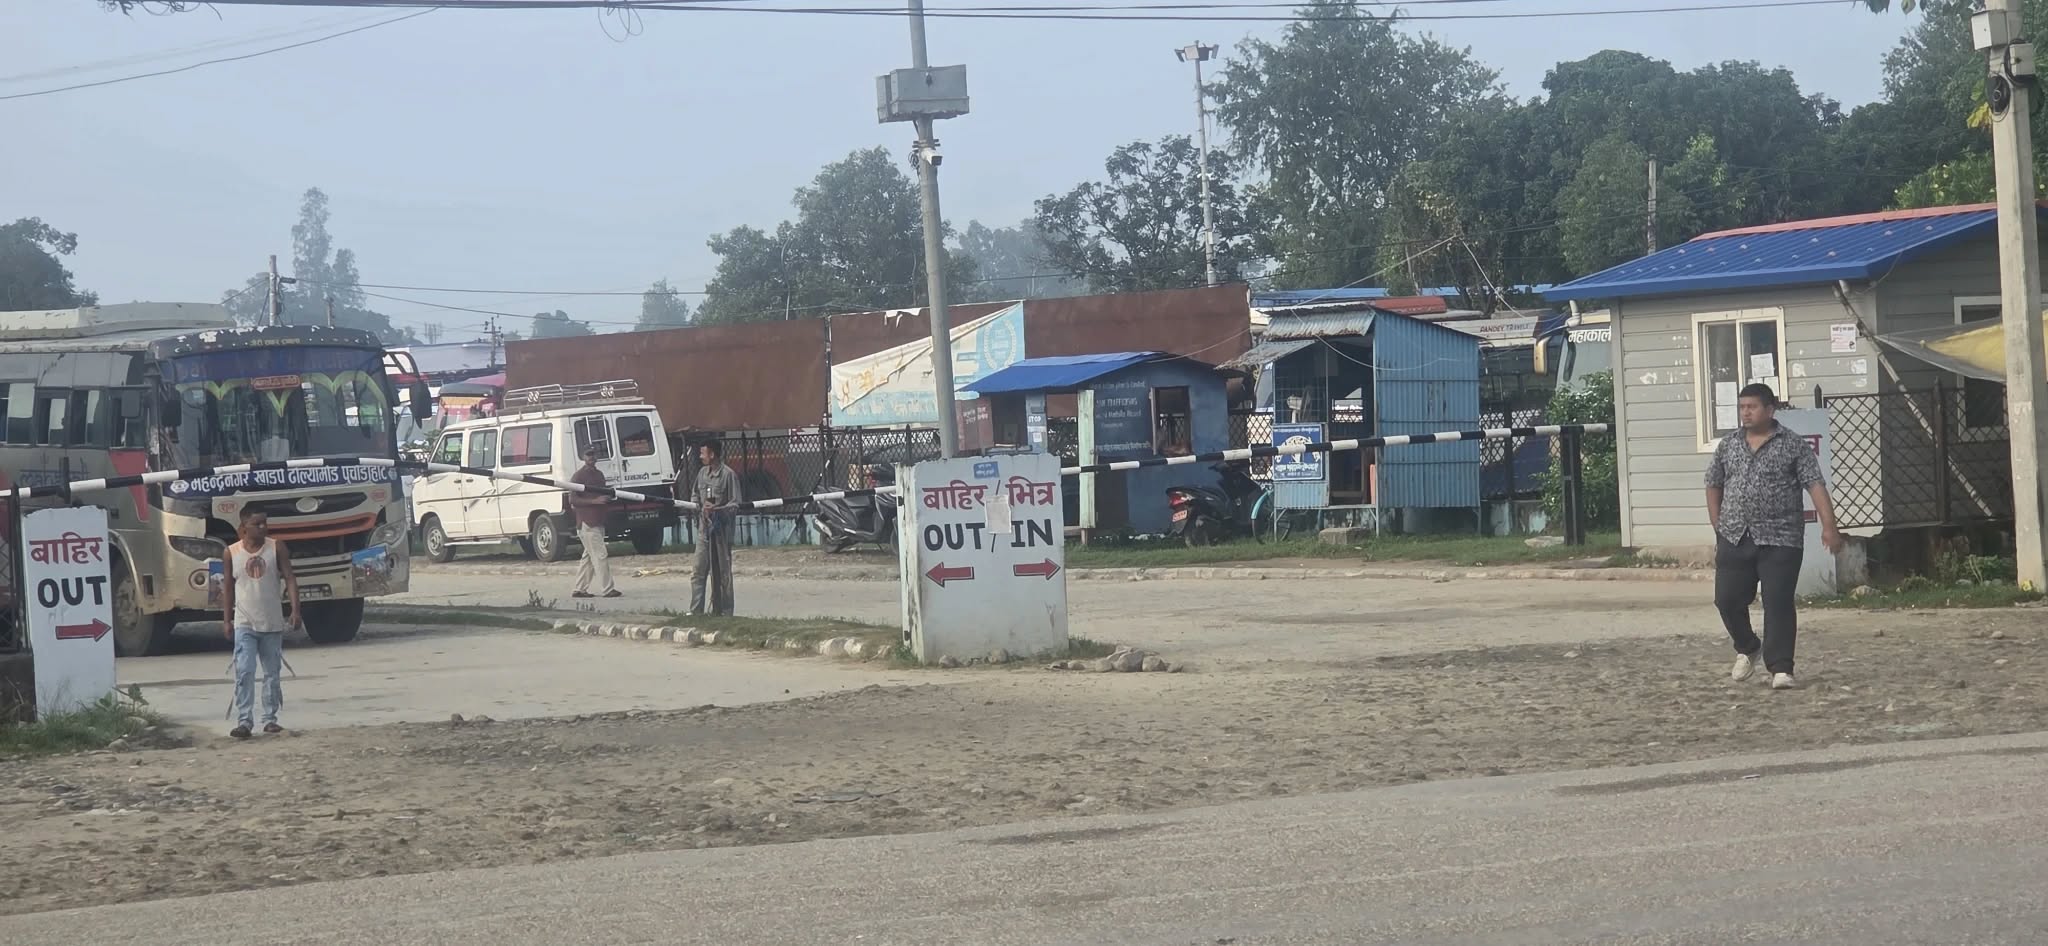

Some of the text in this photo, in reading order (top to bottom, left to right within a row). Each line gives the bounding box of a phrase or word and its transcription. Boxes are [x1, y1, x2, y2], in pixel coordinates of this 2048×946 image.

[922, 479, 988, 510] बाहिर
[1005, 475, 1056, 507] भित्र
[28, 531, 104, 565] बाहिर
[923, 522, 986, 552] OUT
[1010, 518, 1054, 548] IN
[37, 575, 107, 608] OUT
